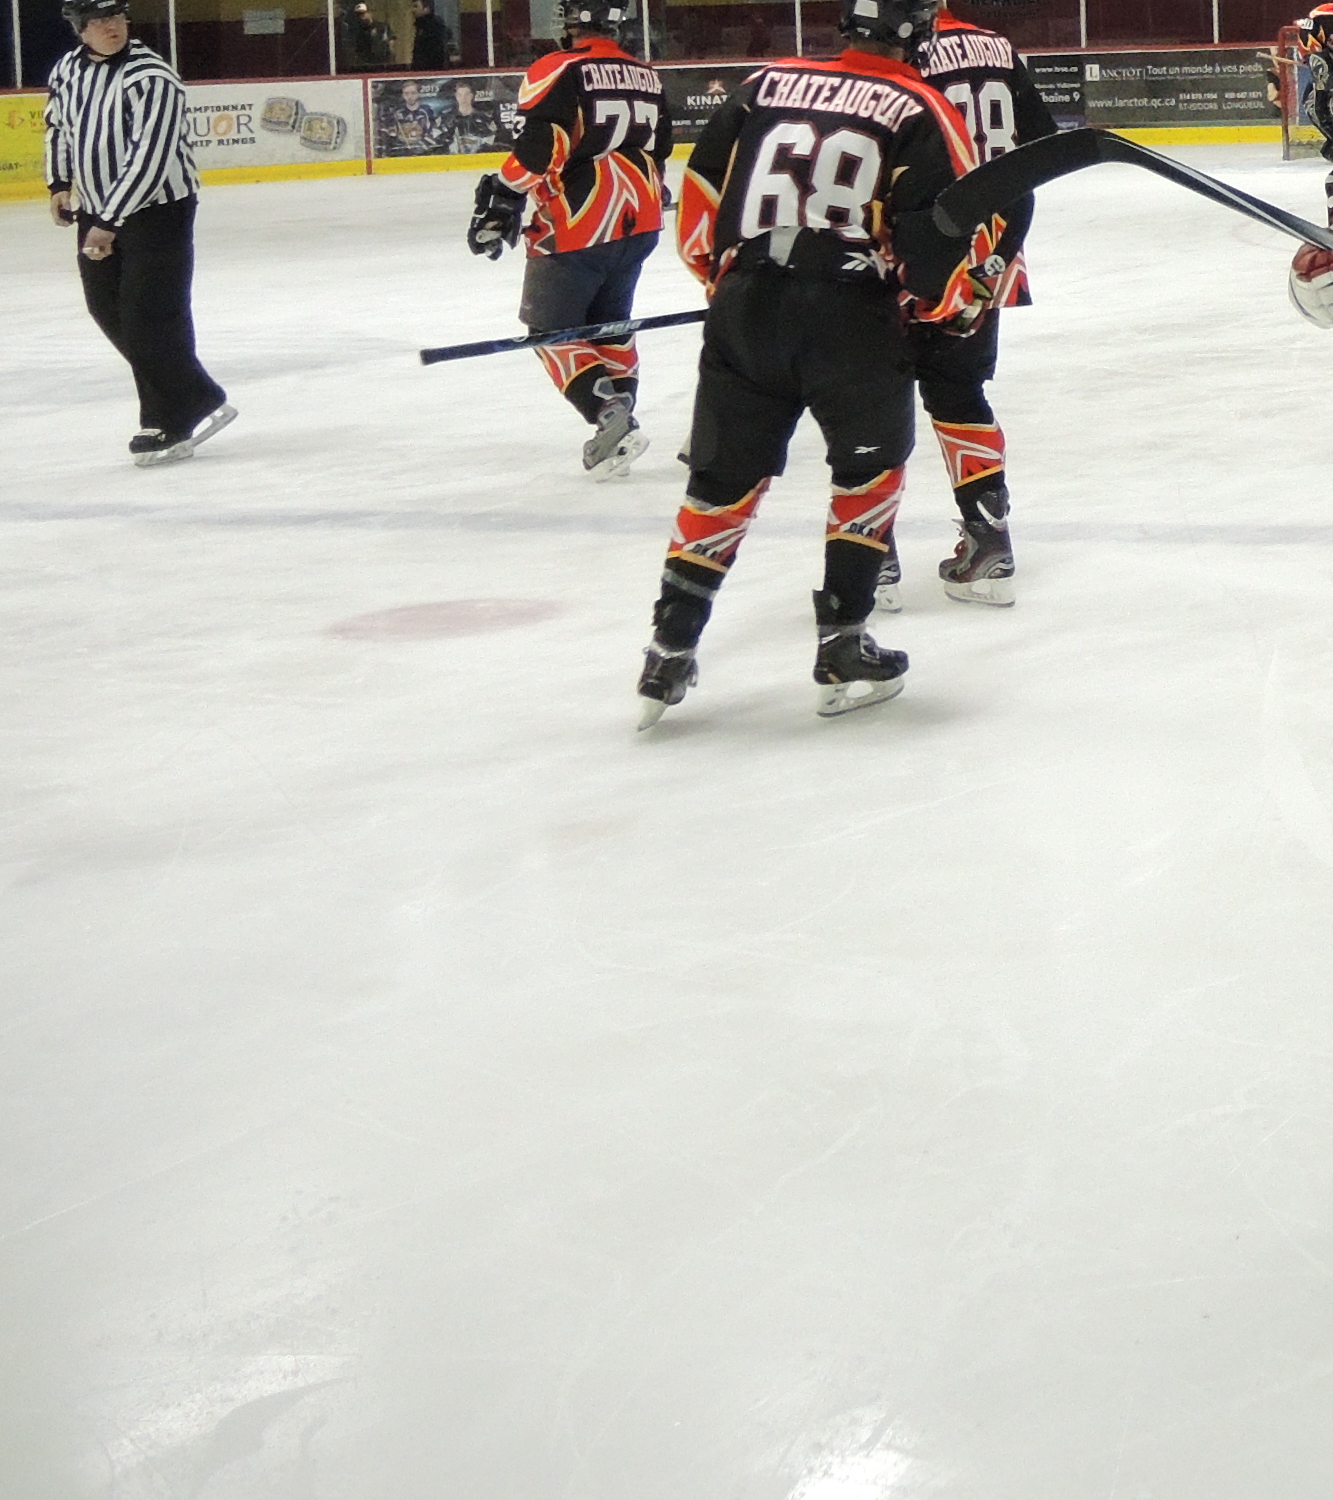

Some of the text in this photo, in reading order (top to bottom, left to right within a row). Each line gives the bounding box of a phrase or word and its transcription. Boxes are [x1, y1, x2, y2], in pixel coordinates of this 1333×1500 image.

[582, 64, 663, 94] CHATEAUGUA
[1147, 66, 1167, 75] Tout
[1182, 64, 1212, 74] monde
[1222, 65, 1237, 73] vos
[1240, 63, 1263, 75] pieds
[186, 104, 254, 113] AMPIONNAT
[687, 95, 728, 105] KINAT
[757, 72, 923, 134] CHATEAUGUAY
[595, 100, 659, 160] 77
[217, 137, 256, 146] RINGS
[740, 121, 883, 241] 68
